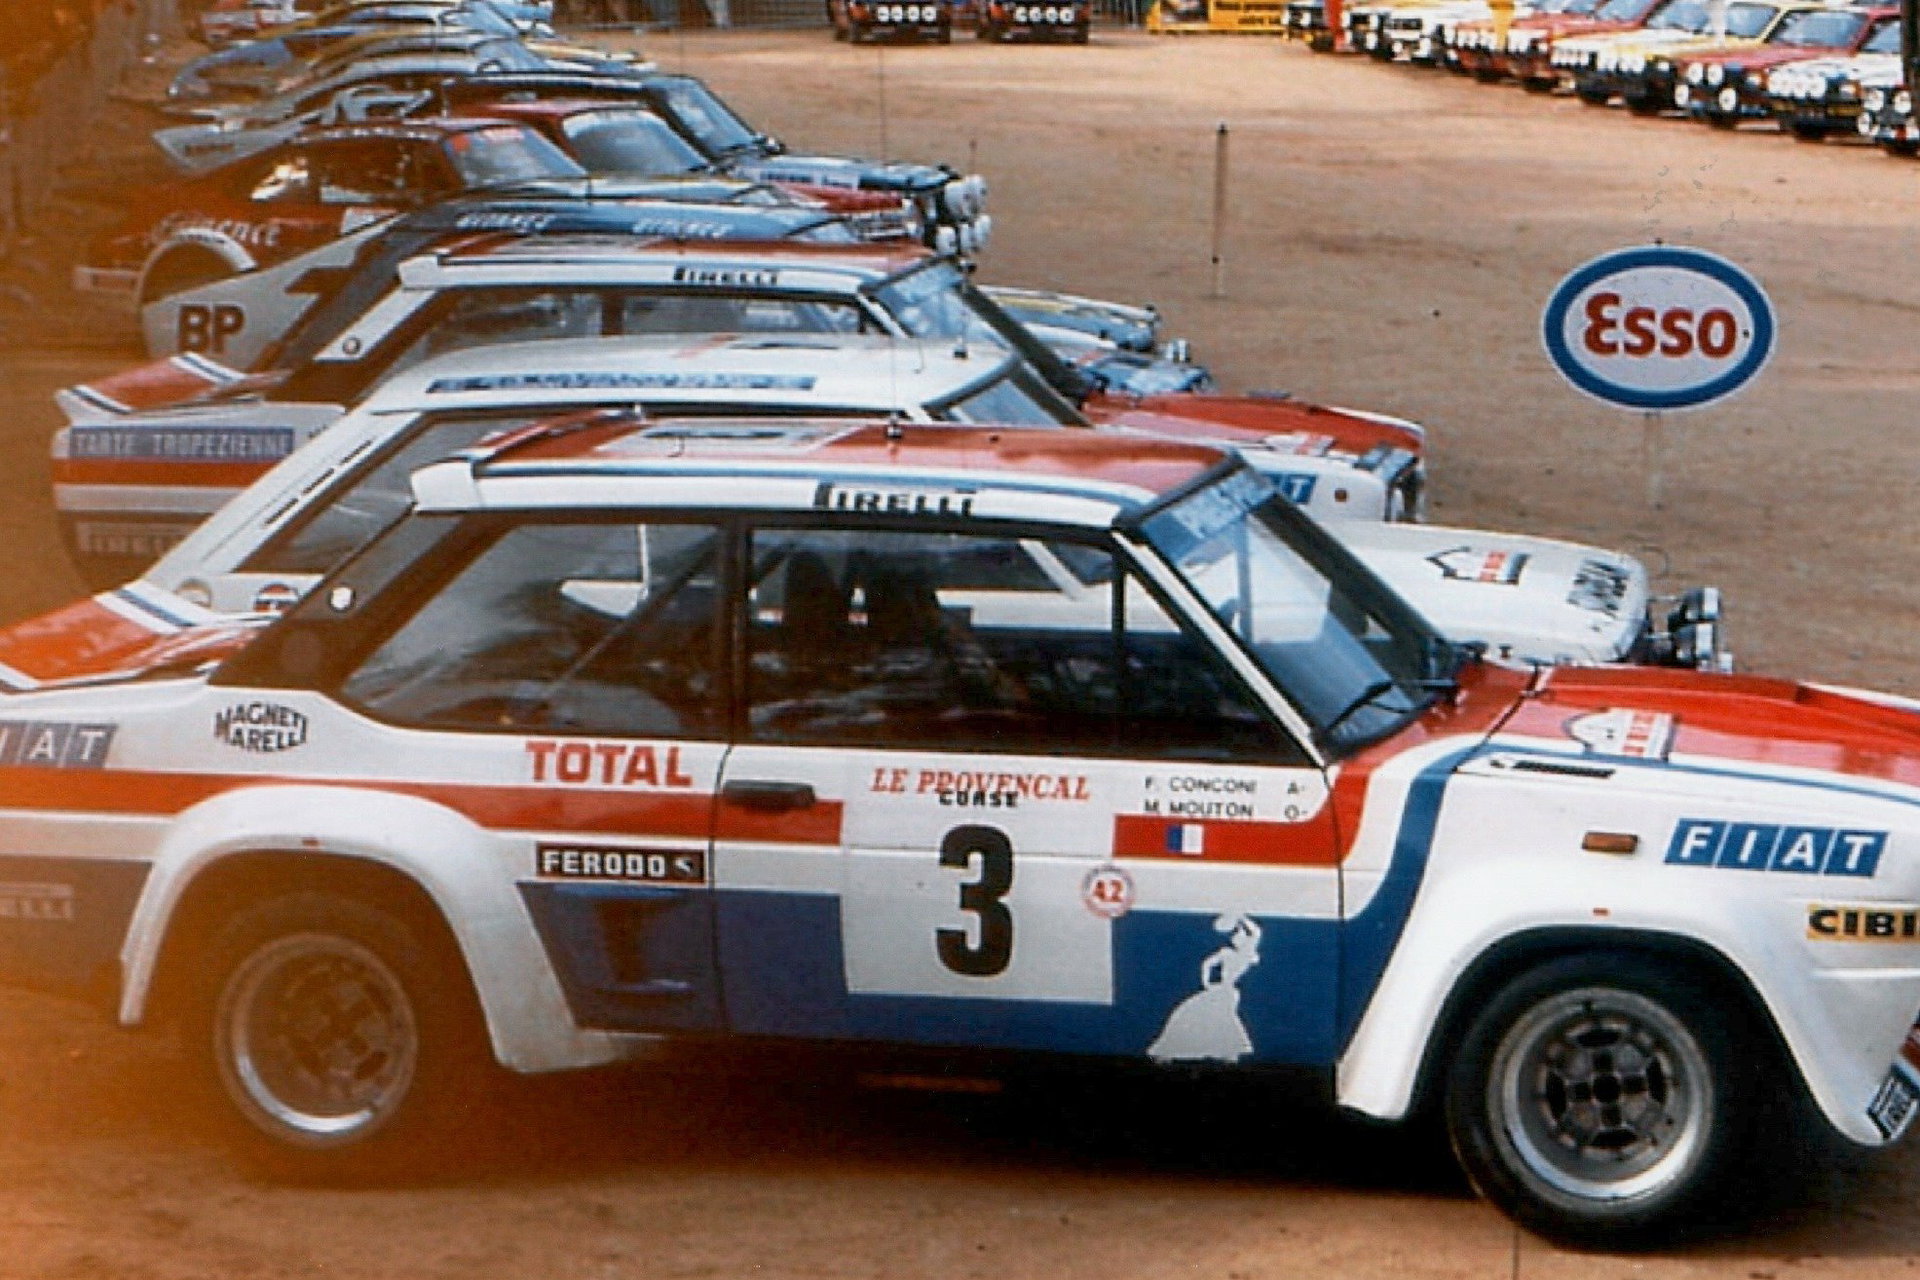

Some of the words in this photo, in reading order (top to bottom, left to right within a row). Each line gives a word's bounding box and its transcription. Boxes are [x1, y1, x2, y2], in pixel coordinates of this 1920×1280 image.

[179, 305, 244, 350] BP
[814, 483, 976, 517] PIRELLI
[526, 742, 693, 787] TOTAL
[870, 768, 908, 792] LE
[1169, 777, 1258, 794] CONCONI
[1170, 801, 1254, 817] MOUTON
[1680, 826, 1874, 870] FIAT
[543, 851, 665, 877] FERODO
[937, 826, 1012, 976] 3
[1093, 880, 1124, 902] 42
